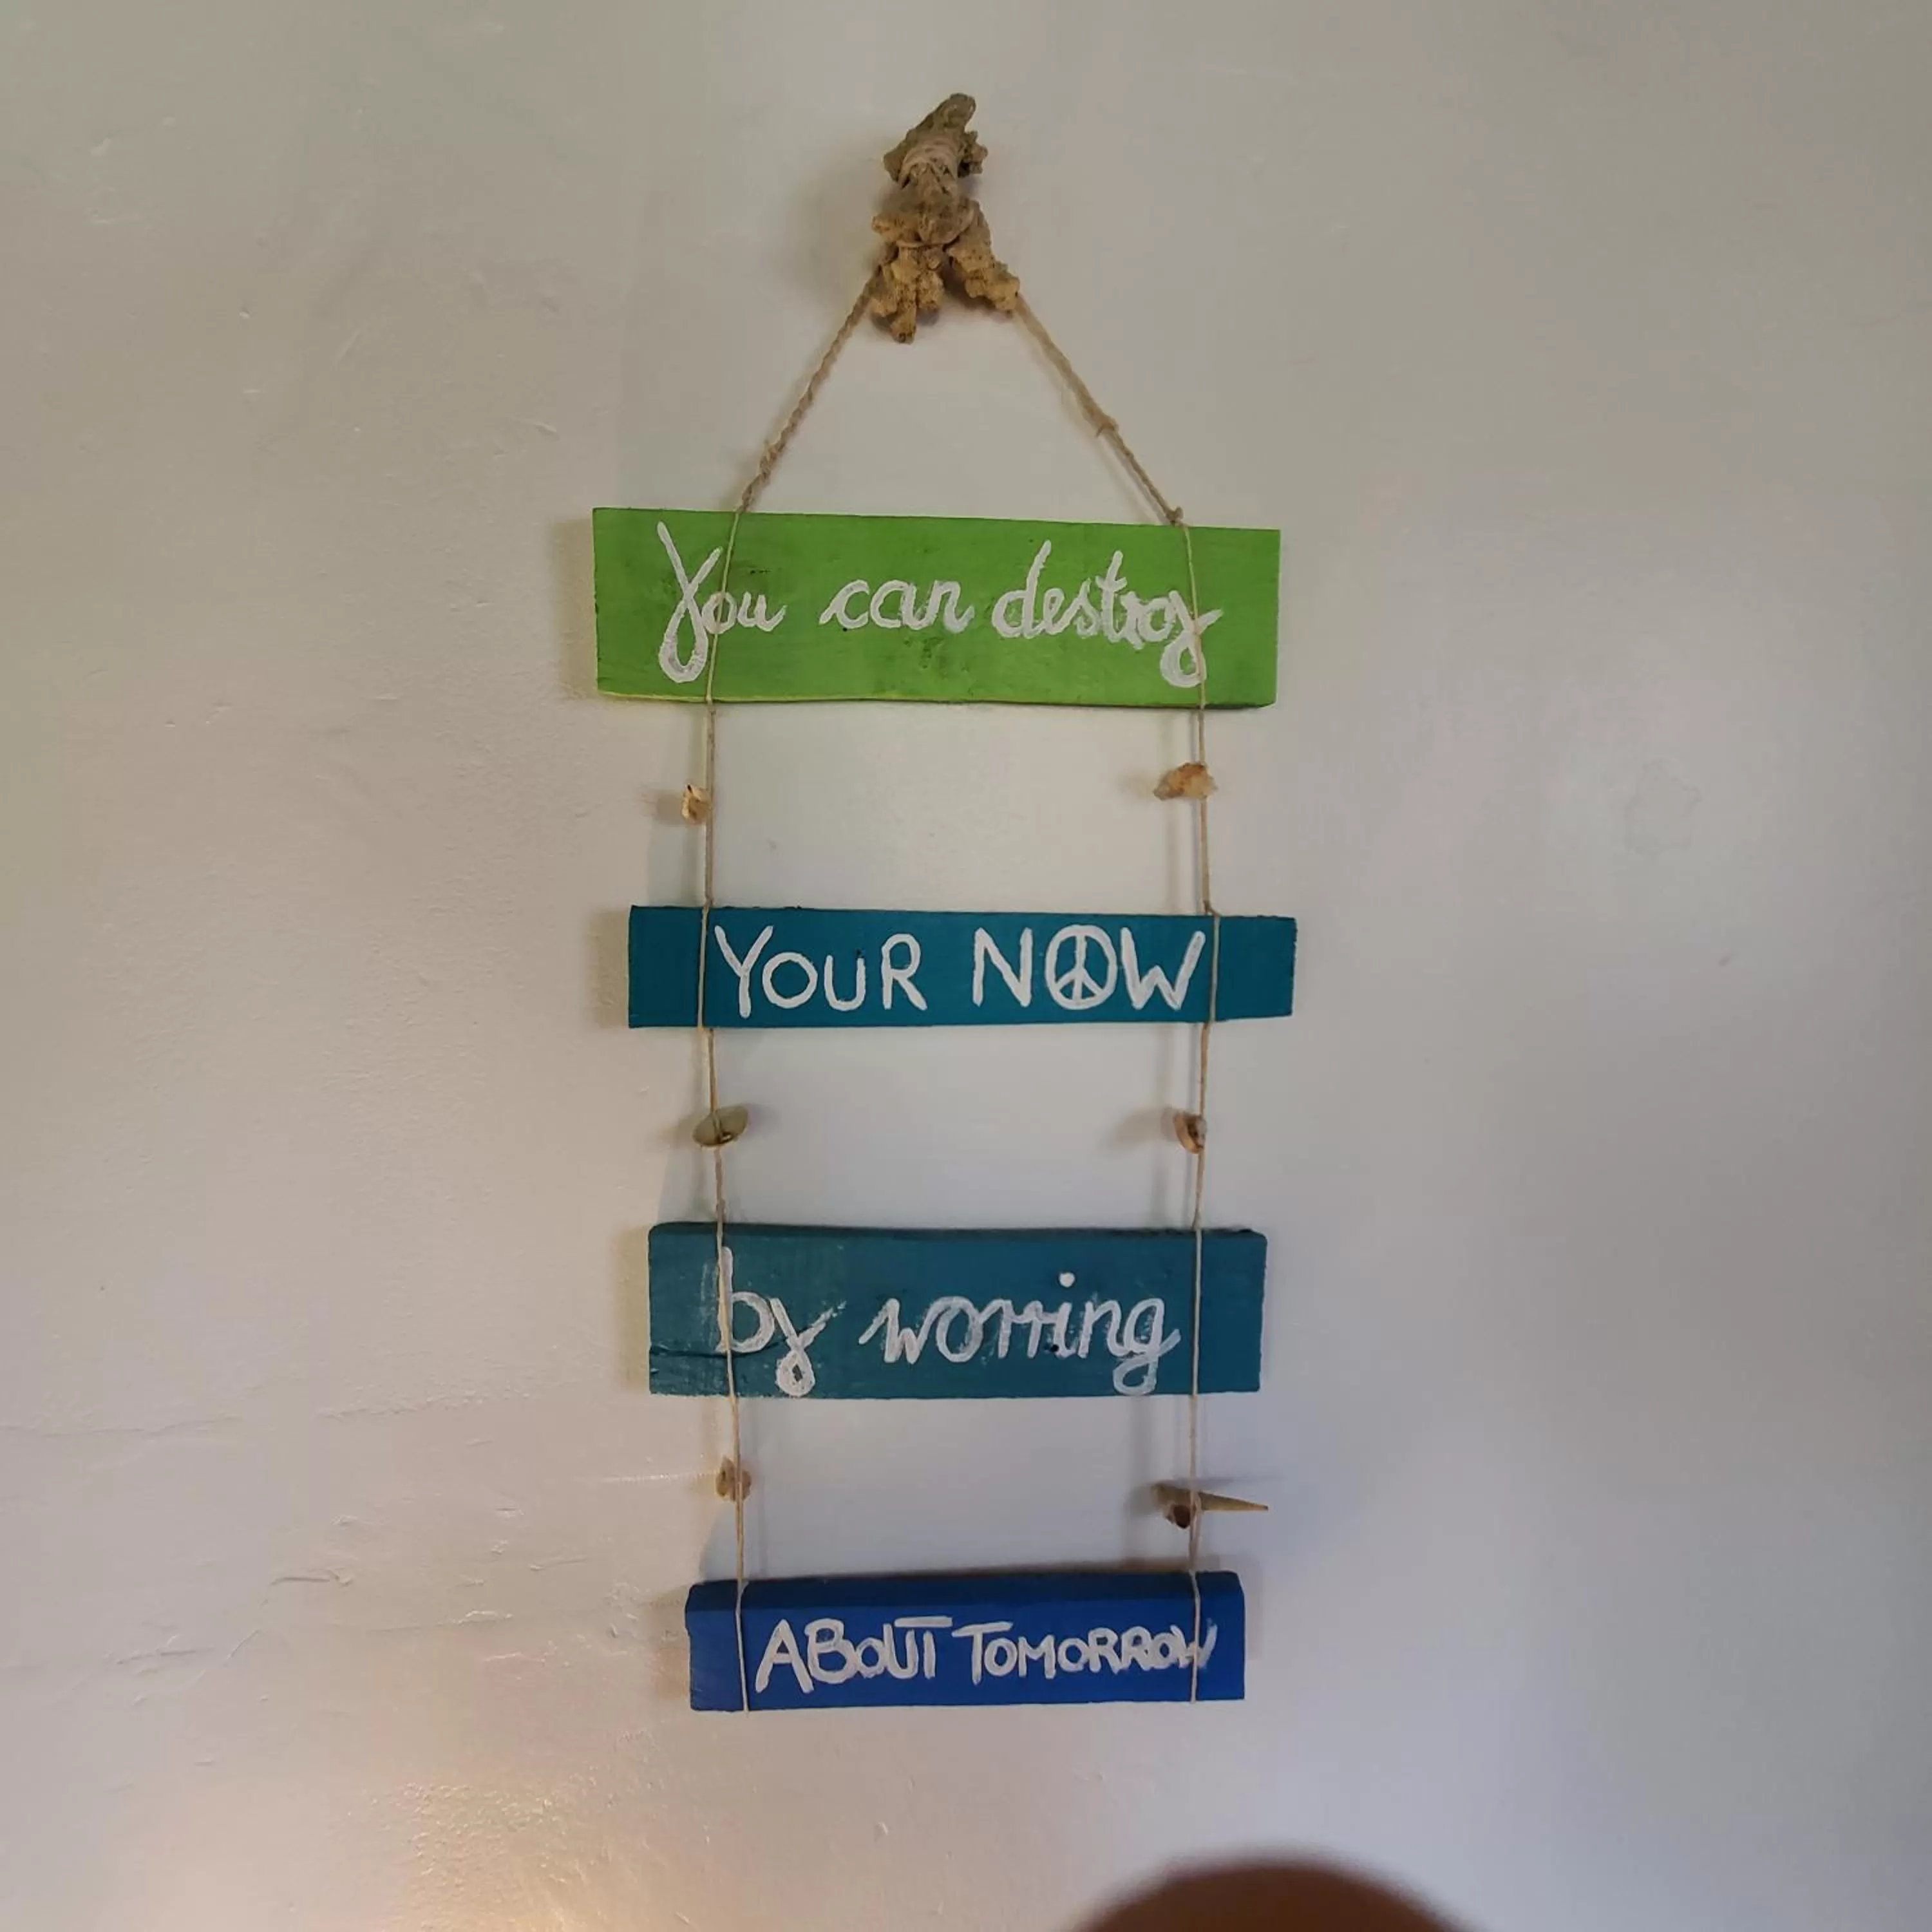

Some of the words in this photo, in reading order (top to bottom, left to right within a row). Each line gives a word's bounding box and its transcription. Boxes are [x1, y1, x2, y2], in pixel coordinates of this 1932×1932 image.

[819, 579, 974, 633] can
[991, 540, 1223, 688] destroy
[714, 925, 928, 1019] YOUR
[972, 923, 1206, 1010] NOW
[715, 1246, 847, 1397] by
[755, 1615, 953, 1694] ABOUT
[952, 1620, 1218, 1685] TOMORROW
